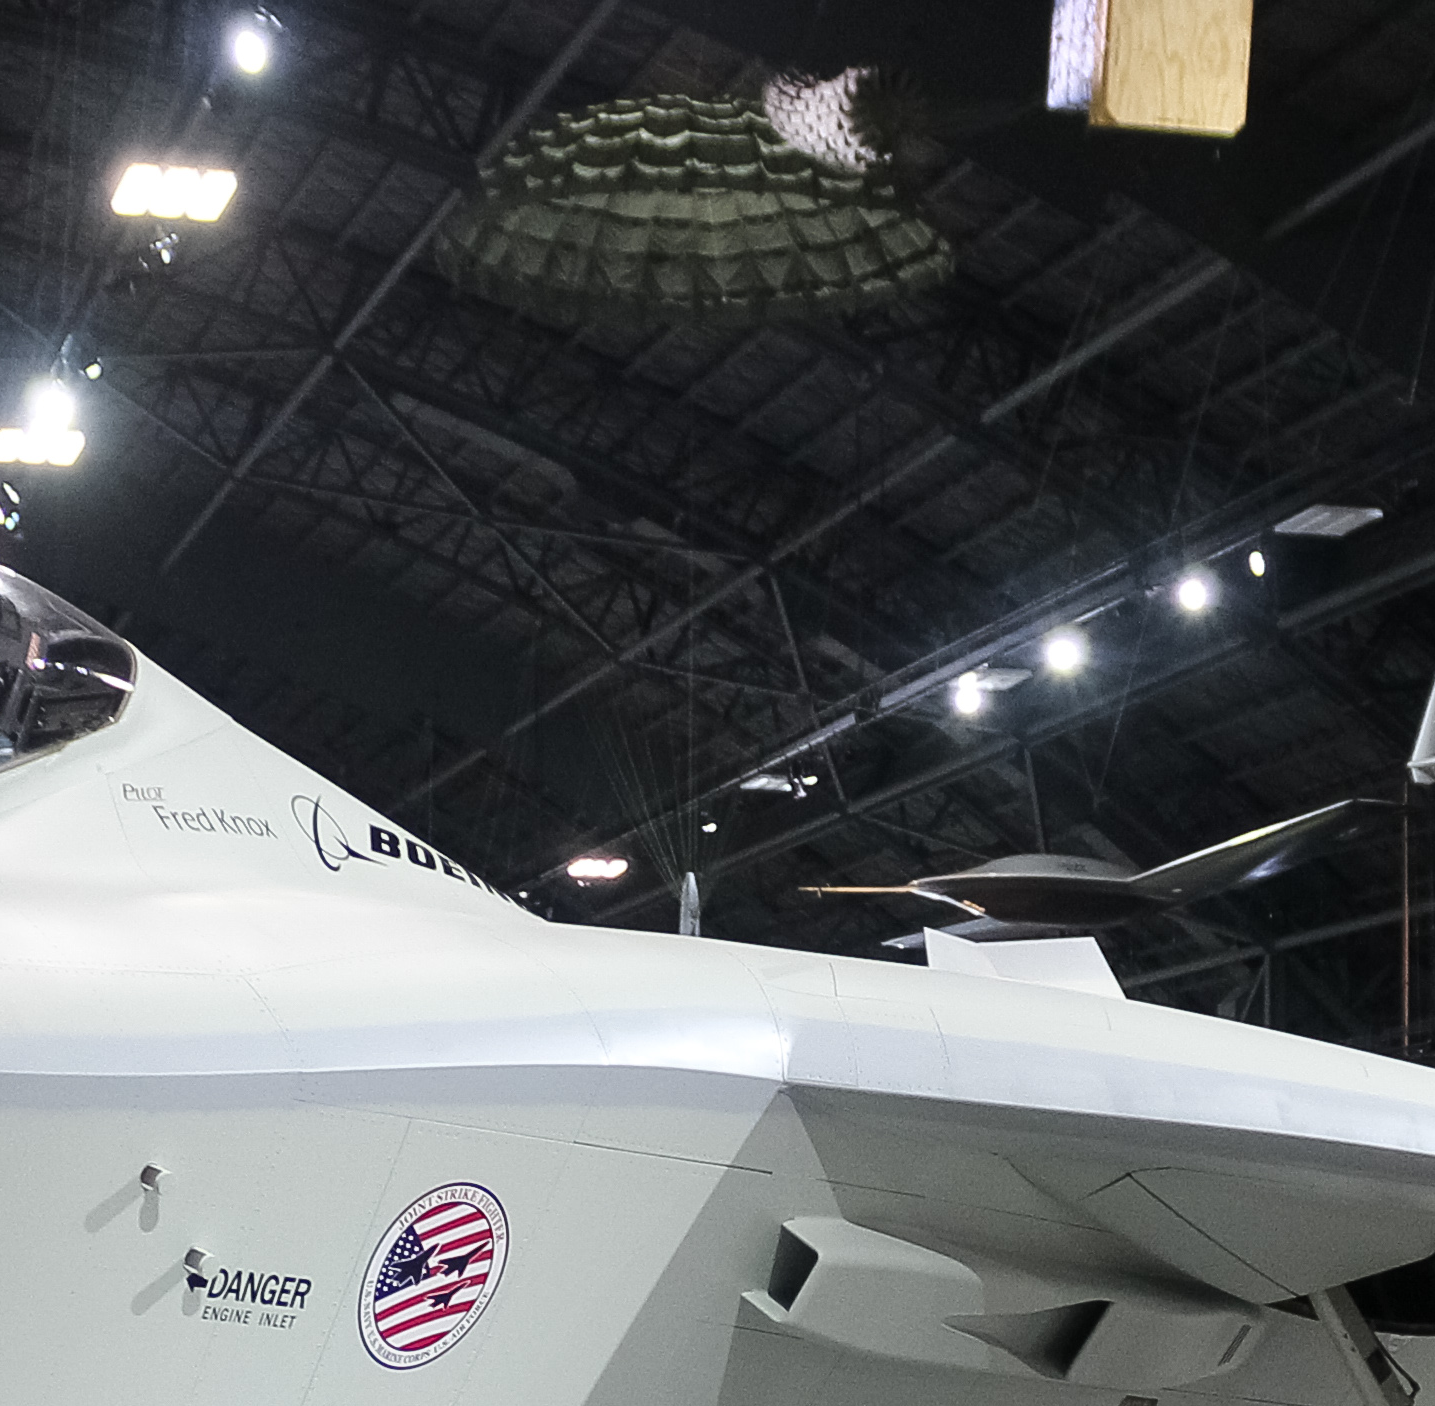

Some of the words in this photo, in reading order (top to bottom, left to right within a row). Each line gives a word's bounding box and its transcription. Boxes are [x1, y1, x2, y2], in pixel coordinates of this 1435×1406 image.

[152, 805, 216, 832] Fred
[211, 808, 278, 839] Knox
[369, 824, 527, 910] BOEI
[398, 1194, 435, 1232] JOINT
[435, 1187, 478, 1203] STRIKE
[480, 1193, 505, 1244] FIGHTER
[207, 1268, 312, 1309] DANGER
[202, 1306, 252, 1325] ENGINE
[258, 1312, 297, 1330] INLET
